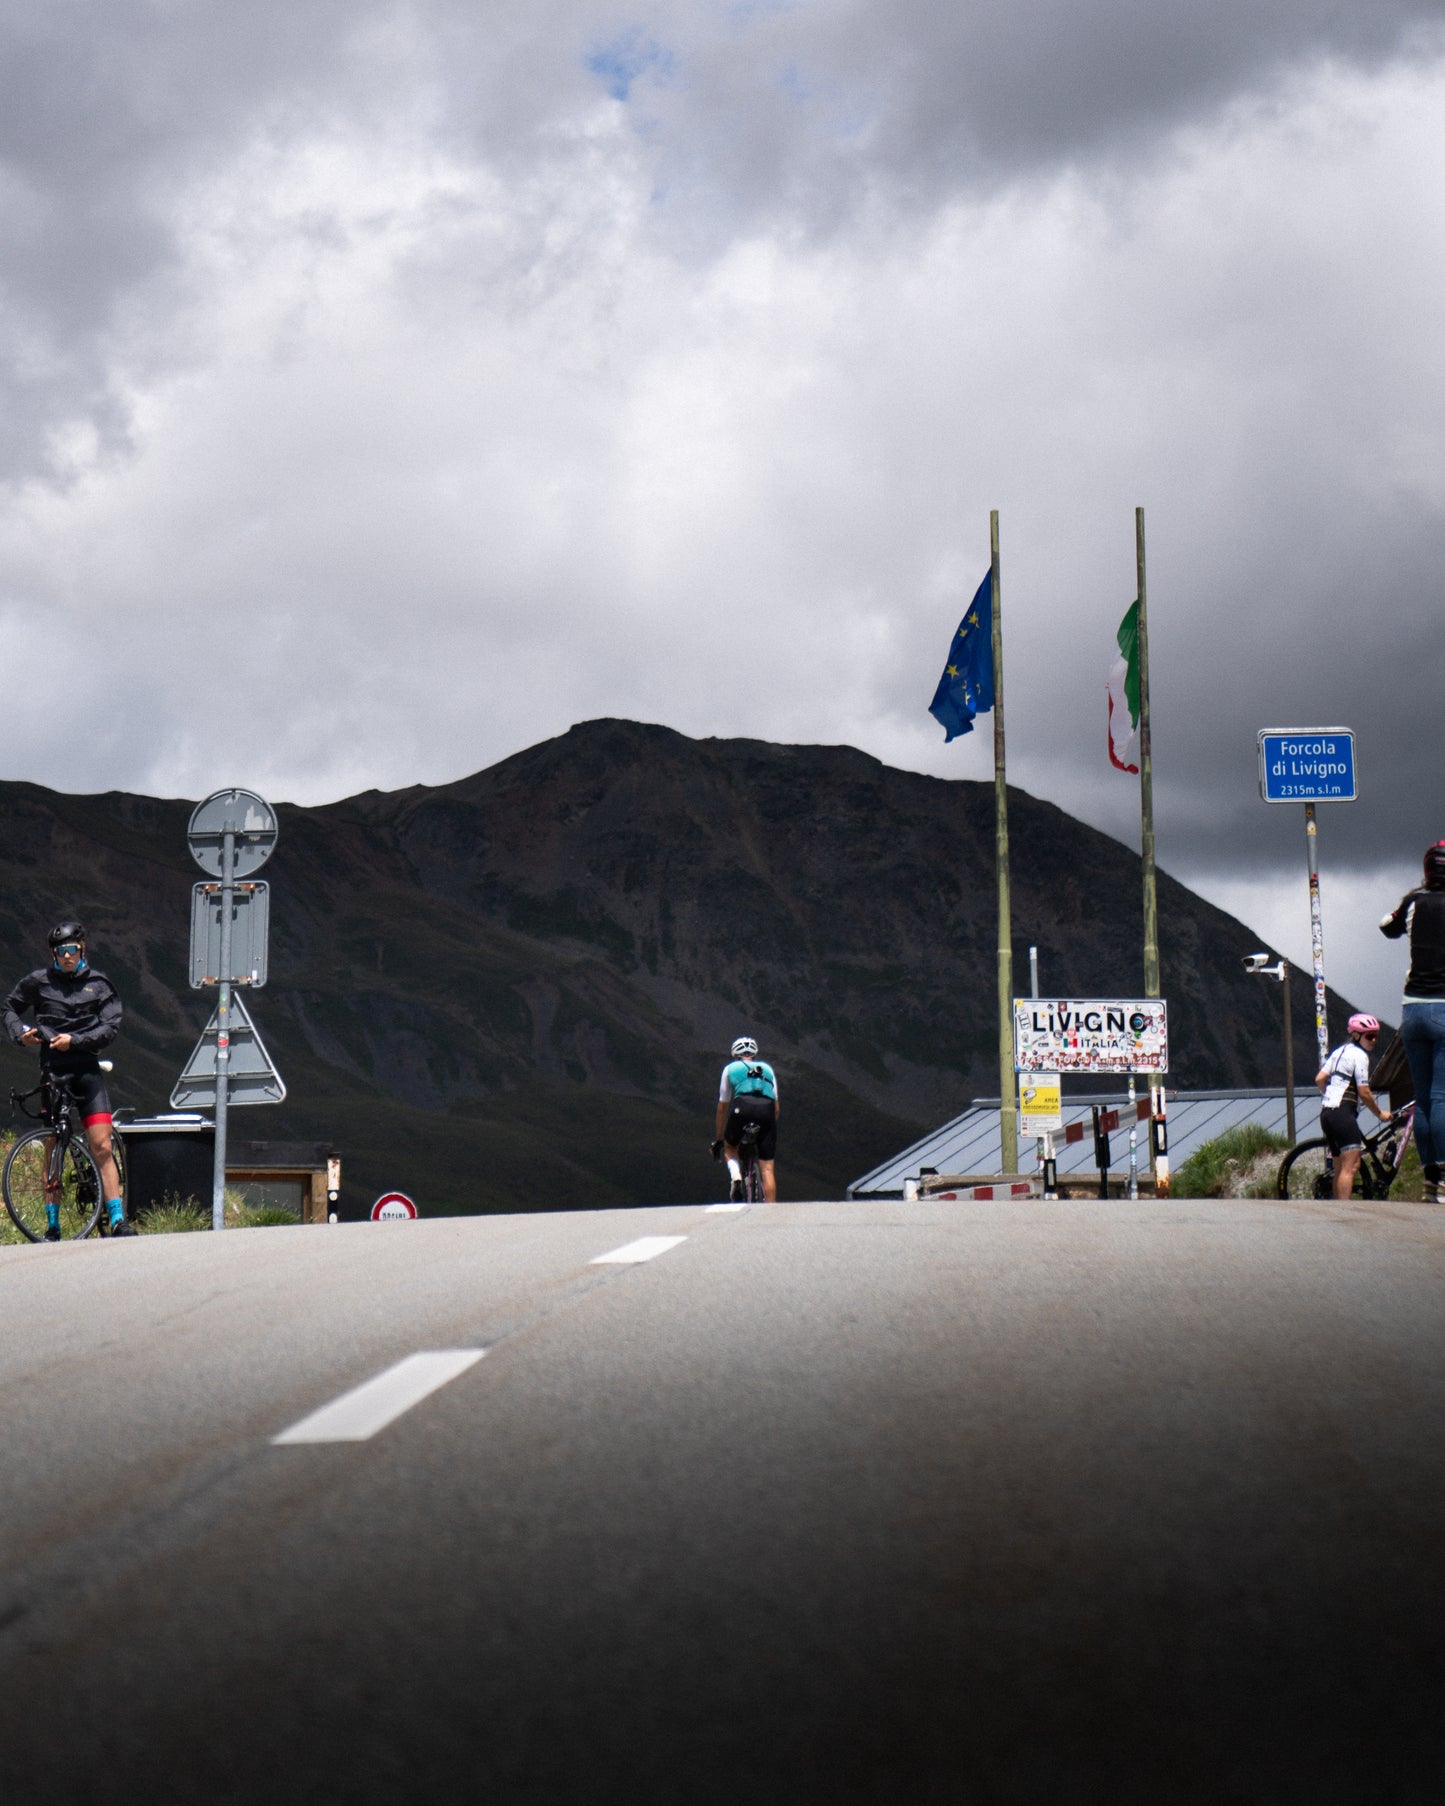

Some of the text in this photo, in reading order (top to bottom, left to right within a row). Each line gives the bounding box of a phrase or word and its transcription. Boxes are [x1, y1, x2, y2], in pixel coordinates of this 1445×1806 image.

[1281, 740, 1336, 755] Forcola
[1272, 760, 1347, 778] di Livigno
[1281, 785, 1315, 796] 2315m
[1032, 1012, 1149, 1033] LIVIGNO
[1081, 1038, 1119, 1048] ITALIA
